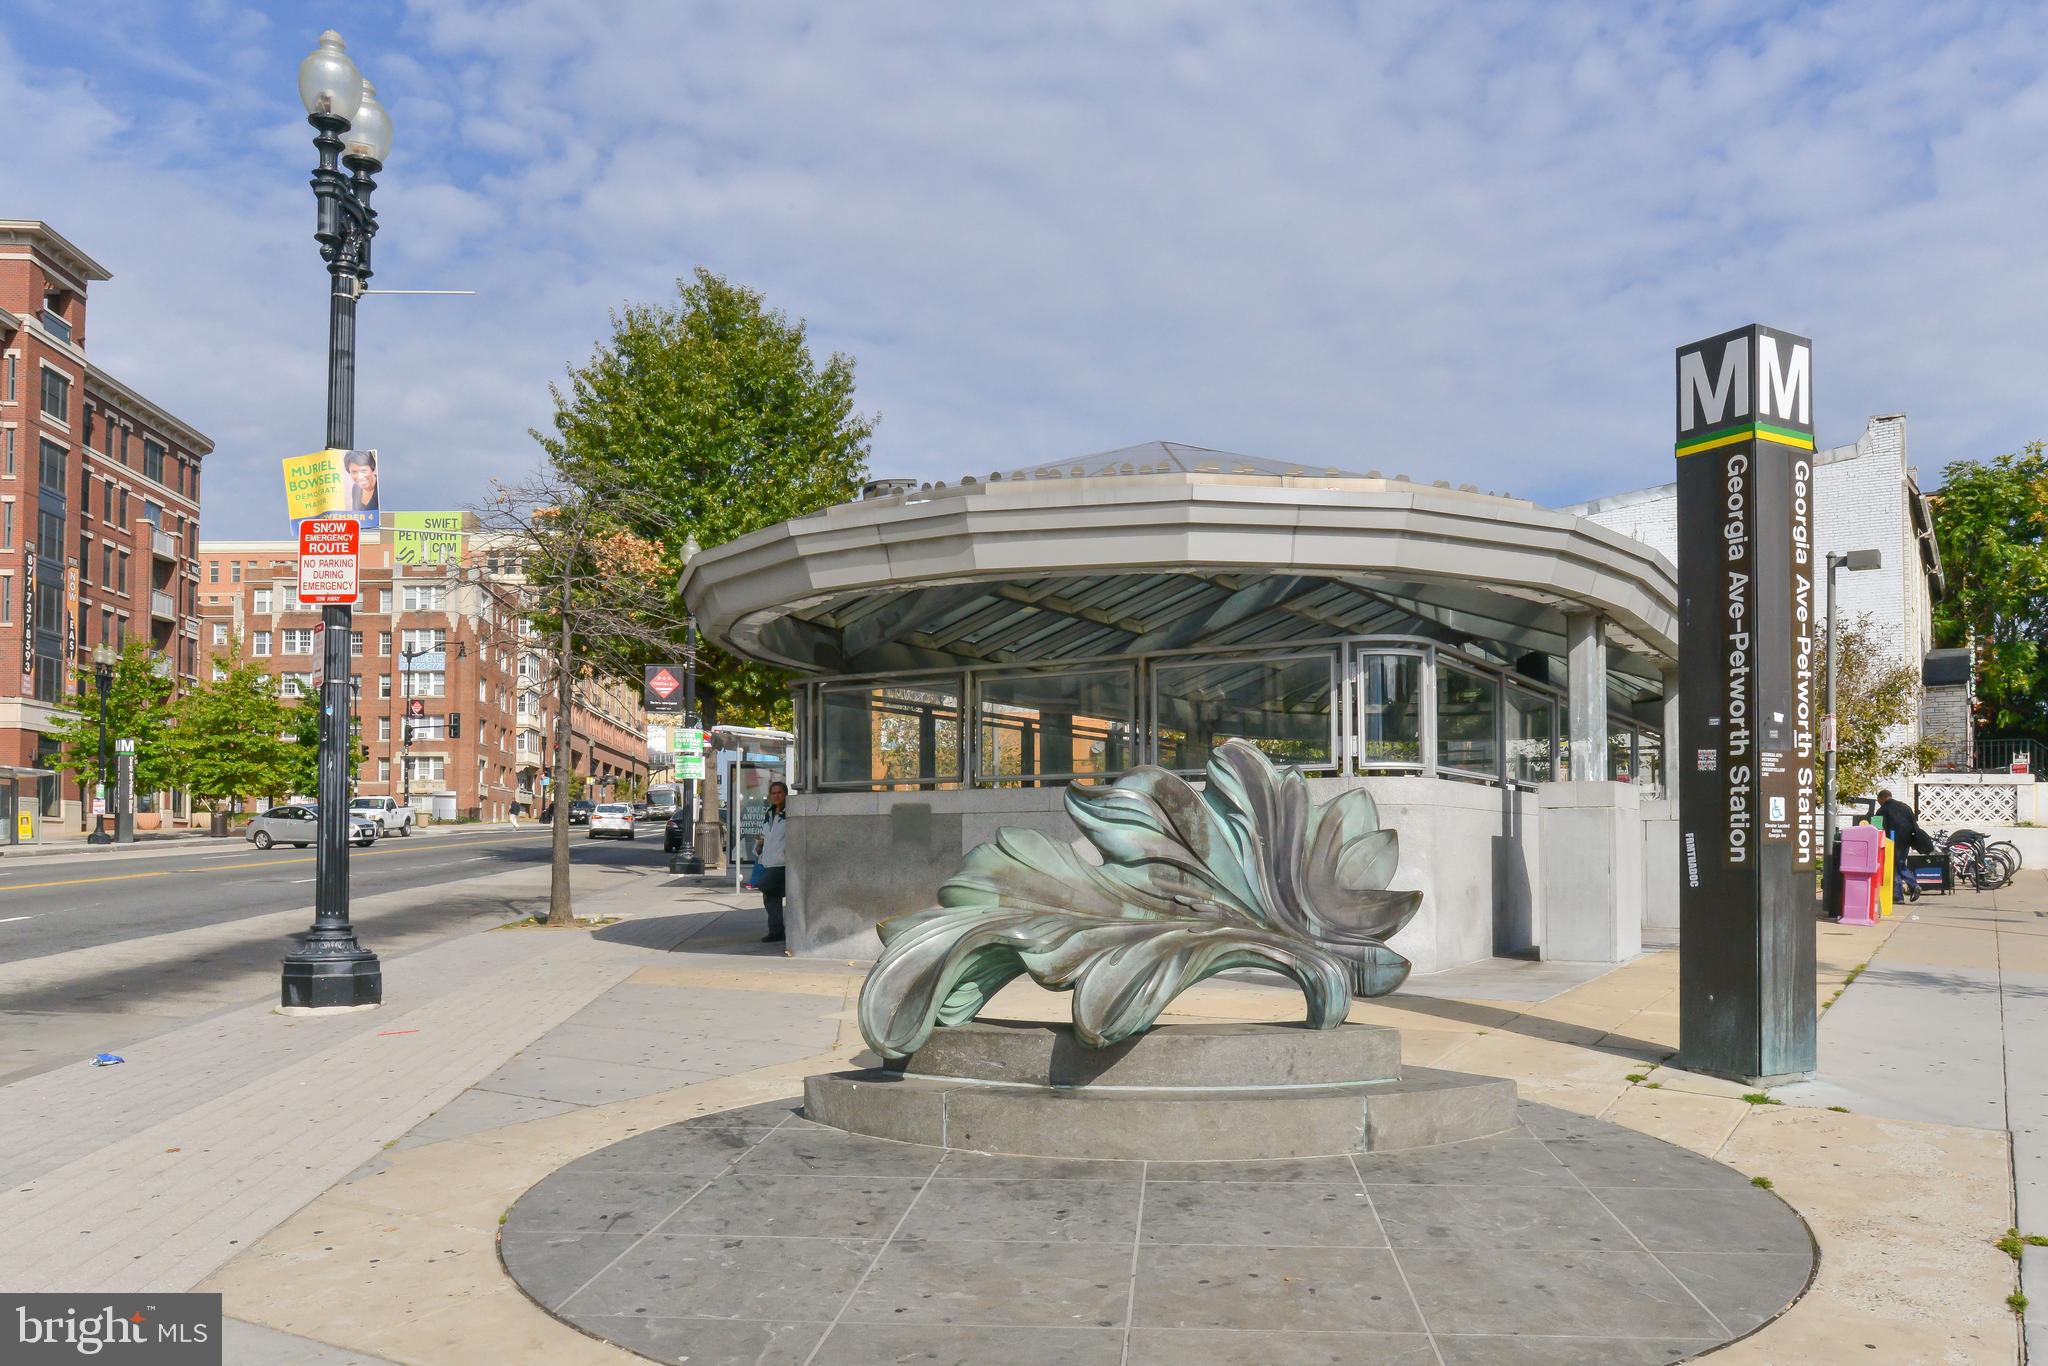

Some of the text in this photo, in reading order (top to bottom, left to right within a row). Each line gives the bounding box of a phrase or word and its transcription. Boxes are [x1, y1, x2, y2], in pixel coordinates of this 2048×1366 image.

[1680, 335, 1749, 432] M
[1759, 334, 1809, 425] M
[291, 460, 336, 478] MURIEL
[289, 473, 341, 492] BOWSER
[1724, 454, 1748, 561] Georgia
[1792, 460, 1810, 564] Georgia
[368, 512, 375, 521] 4
[312, 522, 347, 533] SNOW
[425, 518, 458, 529] SWIFT
[305, 533, 353, 542] EMERGENCY
[398, 530, 457, 541] PETWORTH
[309, 542, 349, 553] ROUTE
[303, 558, 354, 569] NO PARKING
[312, 570, 344, 579] DURING
[68, 571, 77, 602] NOW
[302, 581, 353, 591] EMERGENCY
[121, 739, 135, 752] M
[1729, 765, 1750, 862] Station
[1798, 767, 1813, 863] Station
